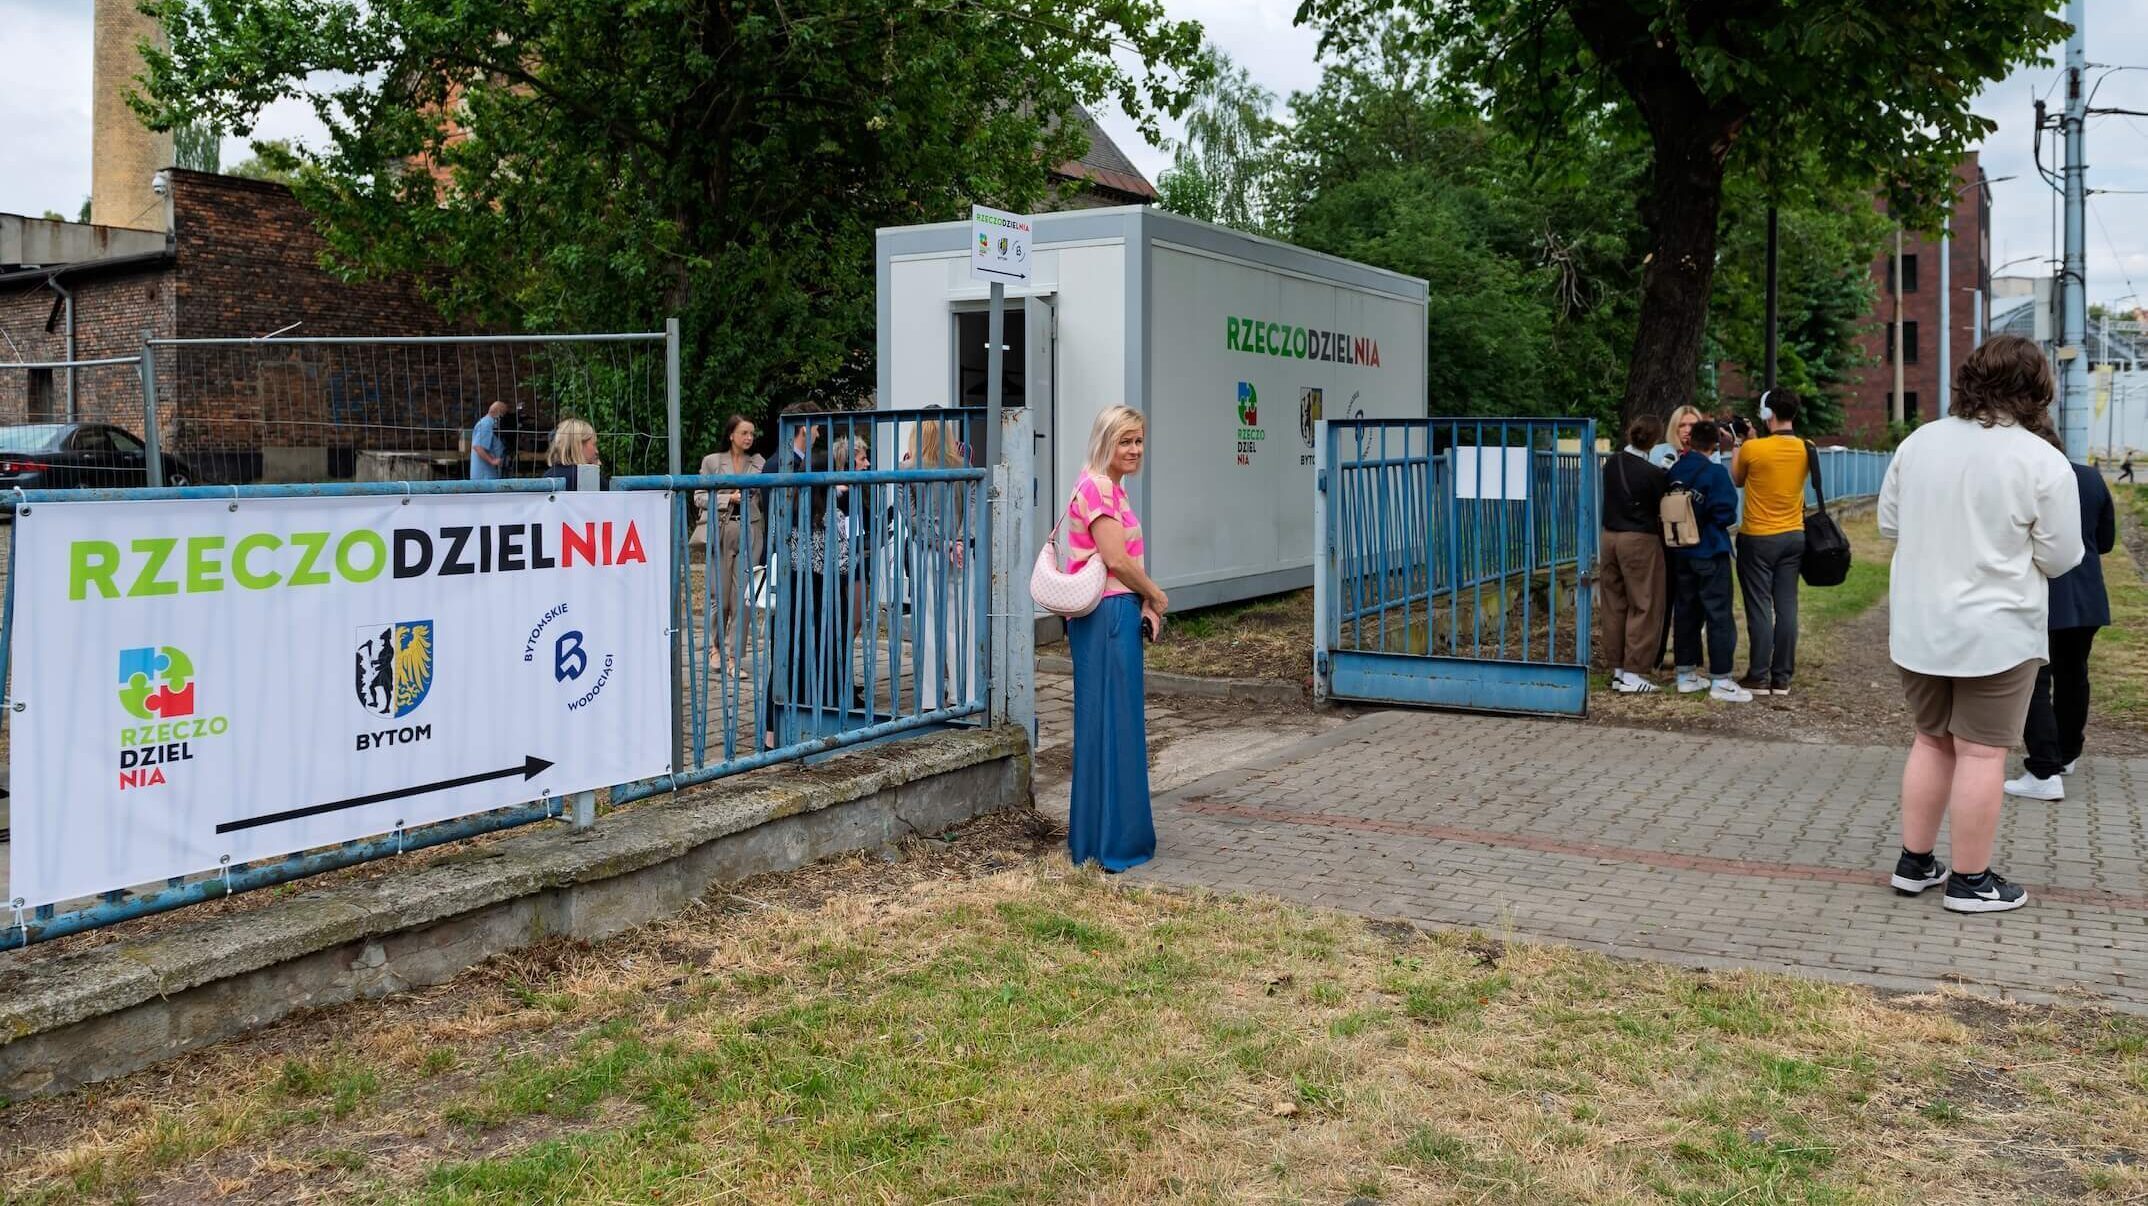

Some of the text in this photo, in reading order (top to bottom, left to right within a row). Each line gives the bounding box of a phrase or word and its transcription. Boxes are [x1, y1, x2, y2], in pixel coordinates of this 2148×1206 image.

[976, 213, 1030, 232] RZECZODZIELNIA
[1227, 316, 1381, 368] RZECZODZIELNIA
[1237, 429, 1265, 441] RZECZO
[1237, 442, 1257, 453] DZIEL
[1237, 455, 1250, 466] NIA
[68, 519, 647, 601] RZECZODZIELNIA
[524, 602, 568, 662] BYTOMSKIE
[568, 653, 613, 711] WODOCIĄGI
[120, 716, 228, 748] RZECZO
[356, 724, 431, 751] BYTOM
[119, 742, 194, 769] DZIEL
[119, 767, 166, 790] NIA
